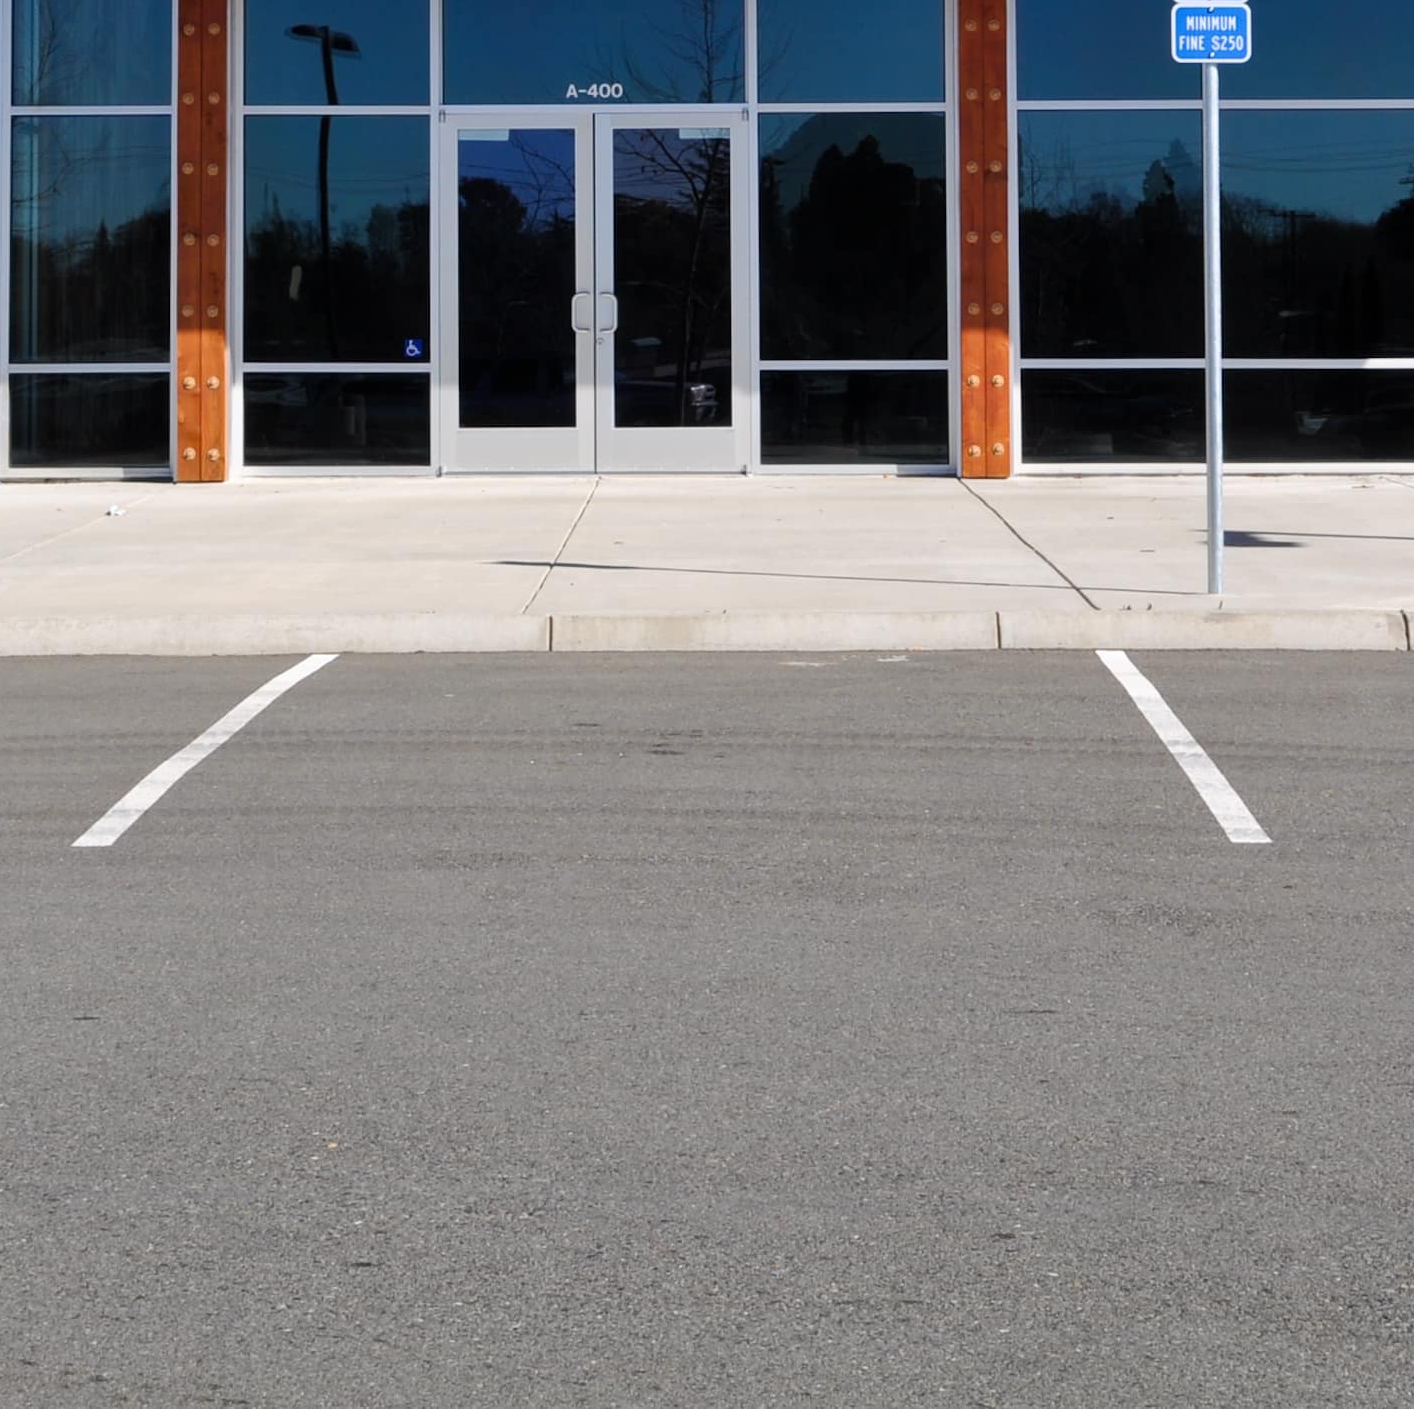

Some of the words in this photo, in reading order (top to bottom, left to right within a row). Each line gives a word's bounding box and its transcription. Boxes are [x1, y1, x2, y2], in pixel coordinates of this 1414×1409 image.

[1186, 15, 1236, 31] MINIMUM
[1179, 35, 1205, 51] FINE
[1211, 35, 1244, 51] $250
[566, 83, 623, 99] A-400
